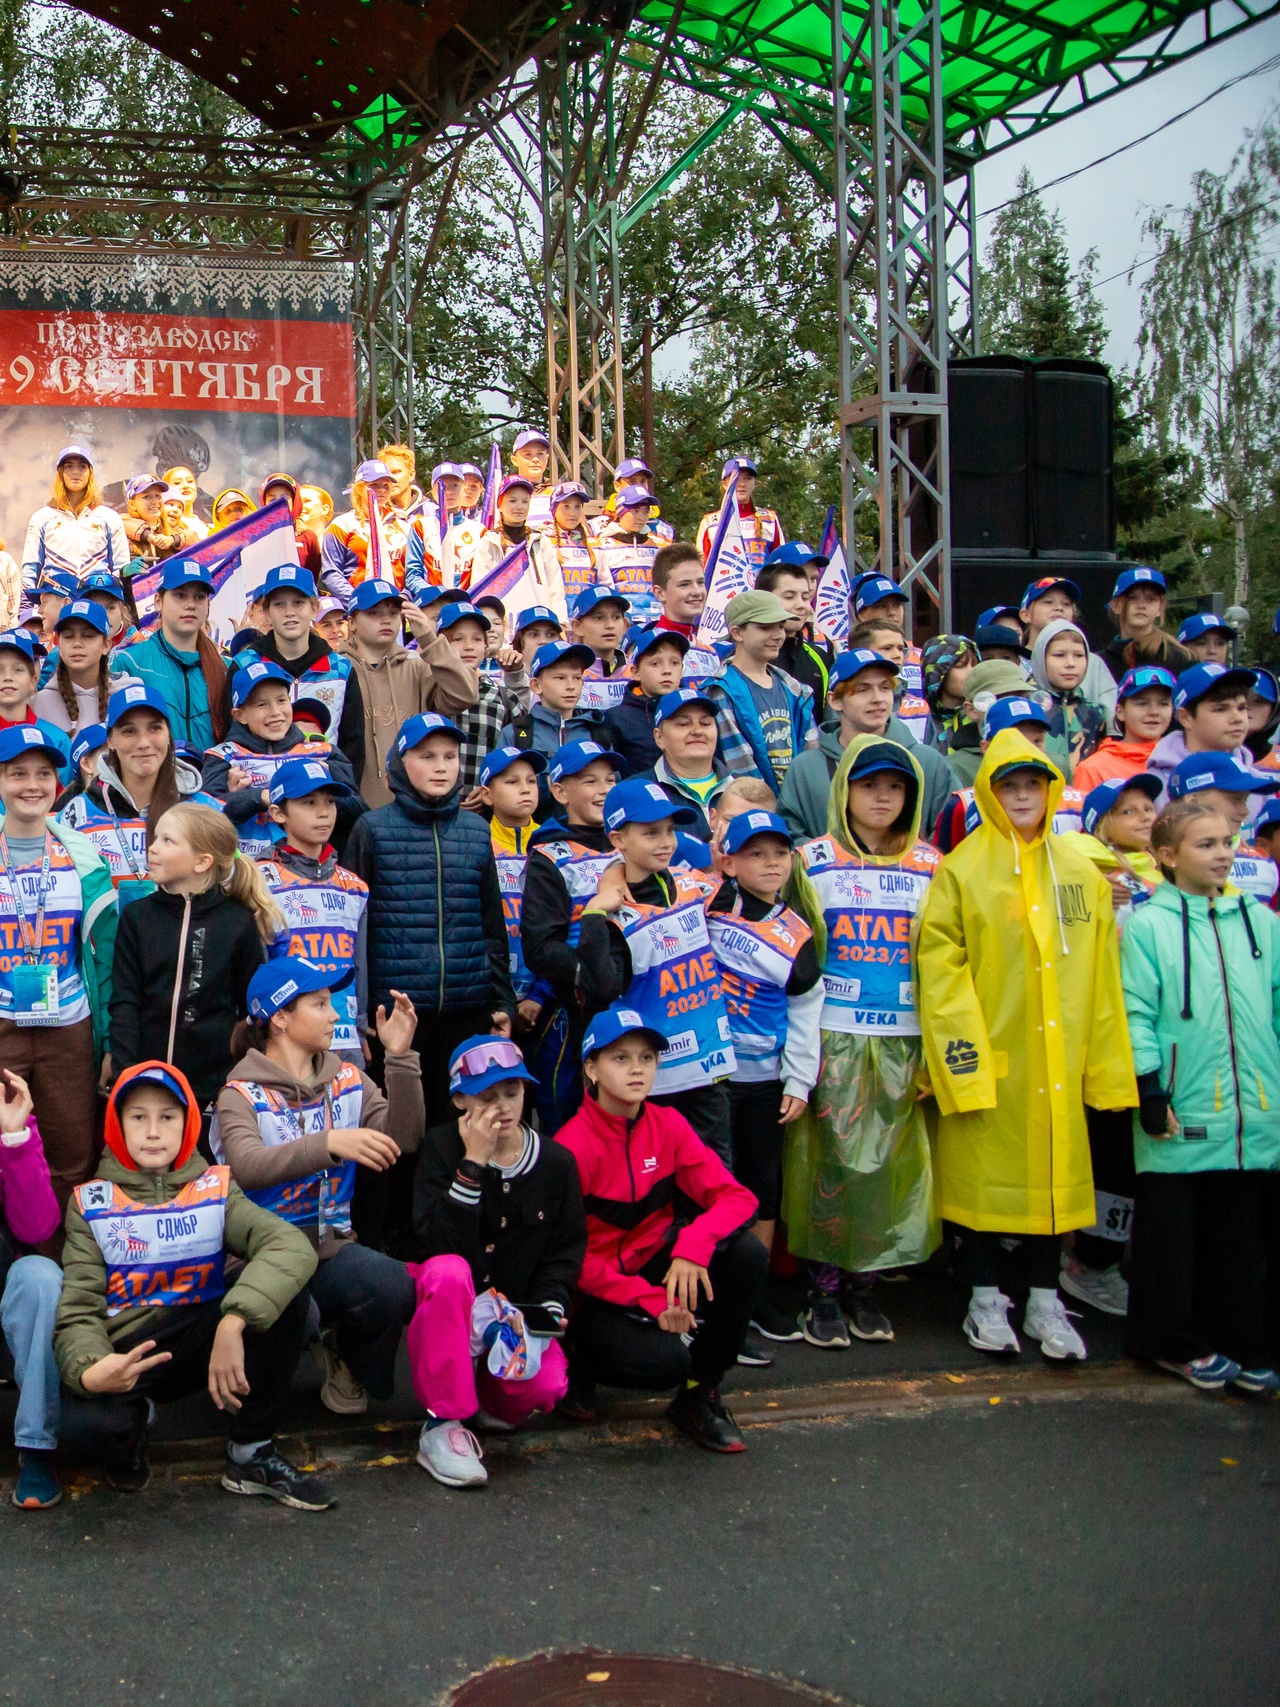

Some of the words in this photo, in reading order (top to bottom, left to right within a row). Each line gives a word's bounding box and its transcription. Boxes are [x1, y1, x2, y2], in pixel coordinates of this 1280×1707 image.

[51, 355, 325, 403] СЕНТЯБРЯ
[434, 557, 473, 573] ЦКА
[616, 569, 653, 583] АТЛЕ
[879, 874, 914, 893] СДЮБР
[770, 923, 797, 949] 261
[833, 914, 910, 943] АТЛЕ
[287, 933, 354, 958] АТЛЕ
[720, 928, 760, 956] СДЮБР
[837, 945, 910, 966] 2023/2
[658, 952, 717, 998] АТЛЕ
[854, 1010, 897, 1025] VEKA
[195, 1175, 220, 1192] 32
[156, 1214, 198, 1241] СДЮБР
[107, 1262, 215, 1299] АТЛЕТ
